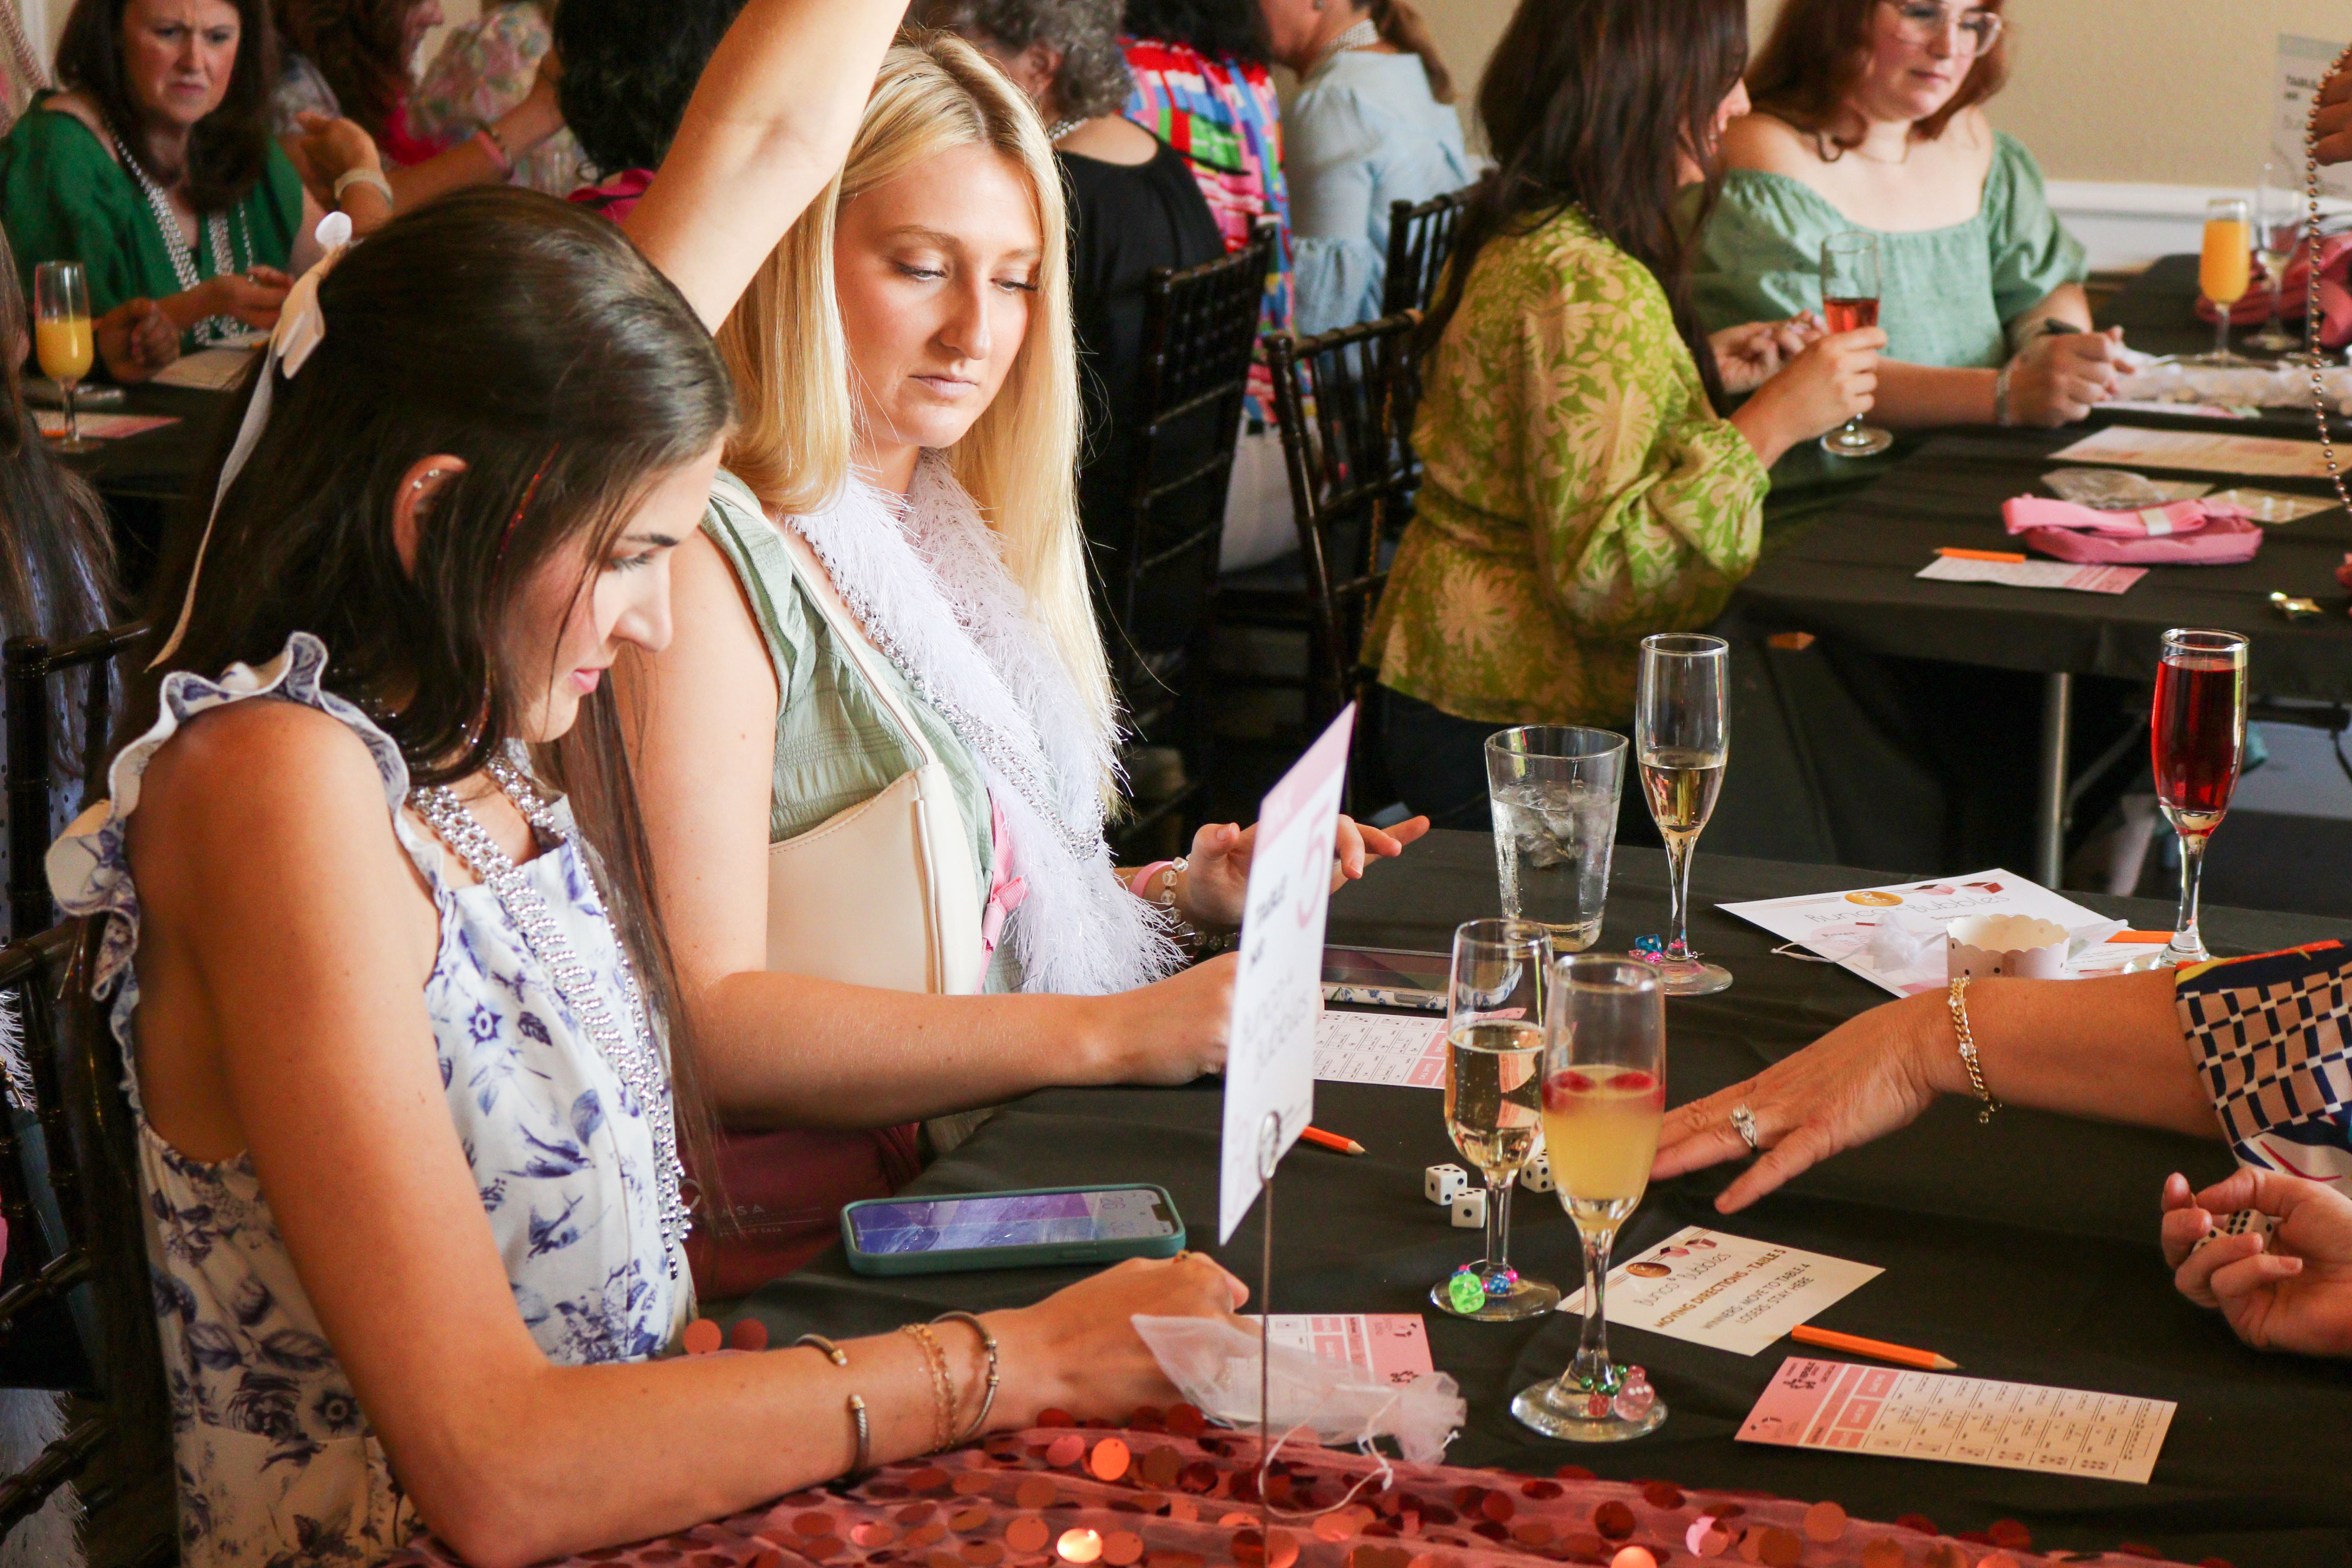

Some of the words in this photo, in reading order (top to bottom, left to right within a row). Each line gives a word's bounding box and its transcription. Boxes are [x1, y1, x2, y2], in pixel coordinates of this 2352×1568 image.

[1297, 801, 1330, 929] 5
[1804, 909, 1890, 922] Bunco
[1906, 895, 2010, 913] Bubbles
[1634, 1283, 1680, 1306] Bunco
[1677, 1254, 1731, 1280] Bubbles
[1654, 1303, 1697, 1328] MOVING
[1690, 1272, 1749, 1304] DIRECTIONS
[1746, 1253, 1781, 1269] TABLE
[1742, 1289, 1769, 1305] MOVE
[1762, 1281, 1781, 1290] TO
[1775, 1267, 1805, 1282] TABLE
[1767, 1290, 1792, 1304] STAY
[1788, 1276, 1814, 1291] HERE
